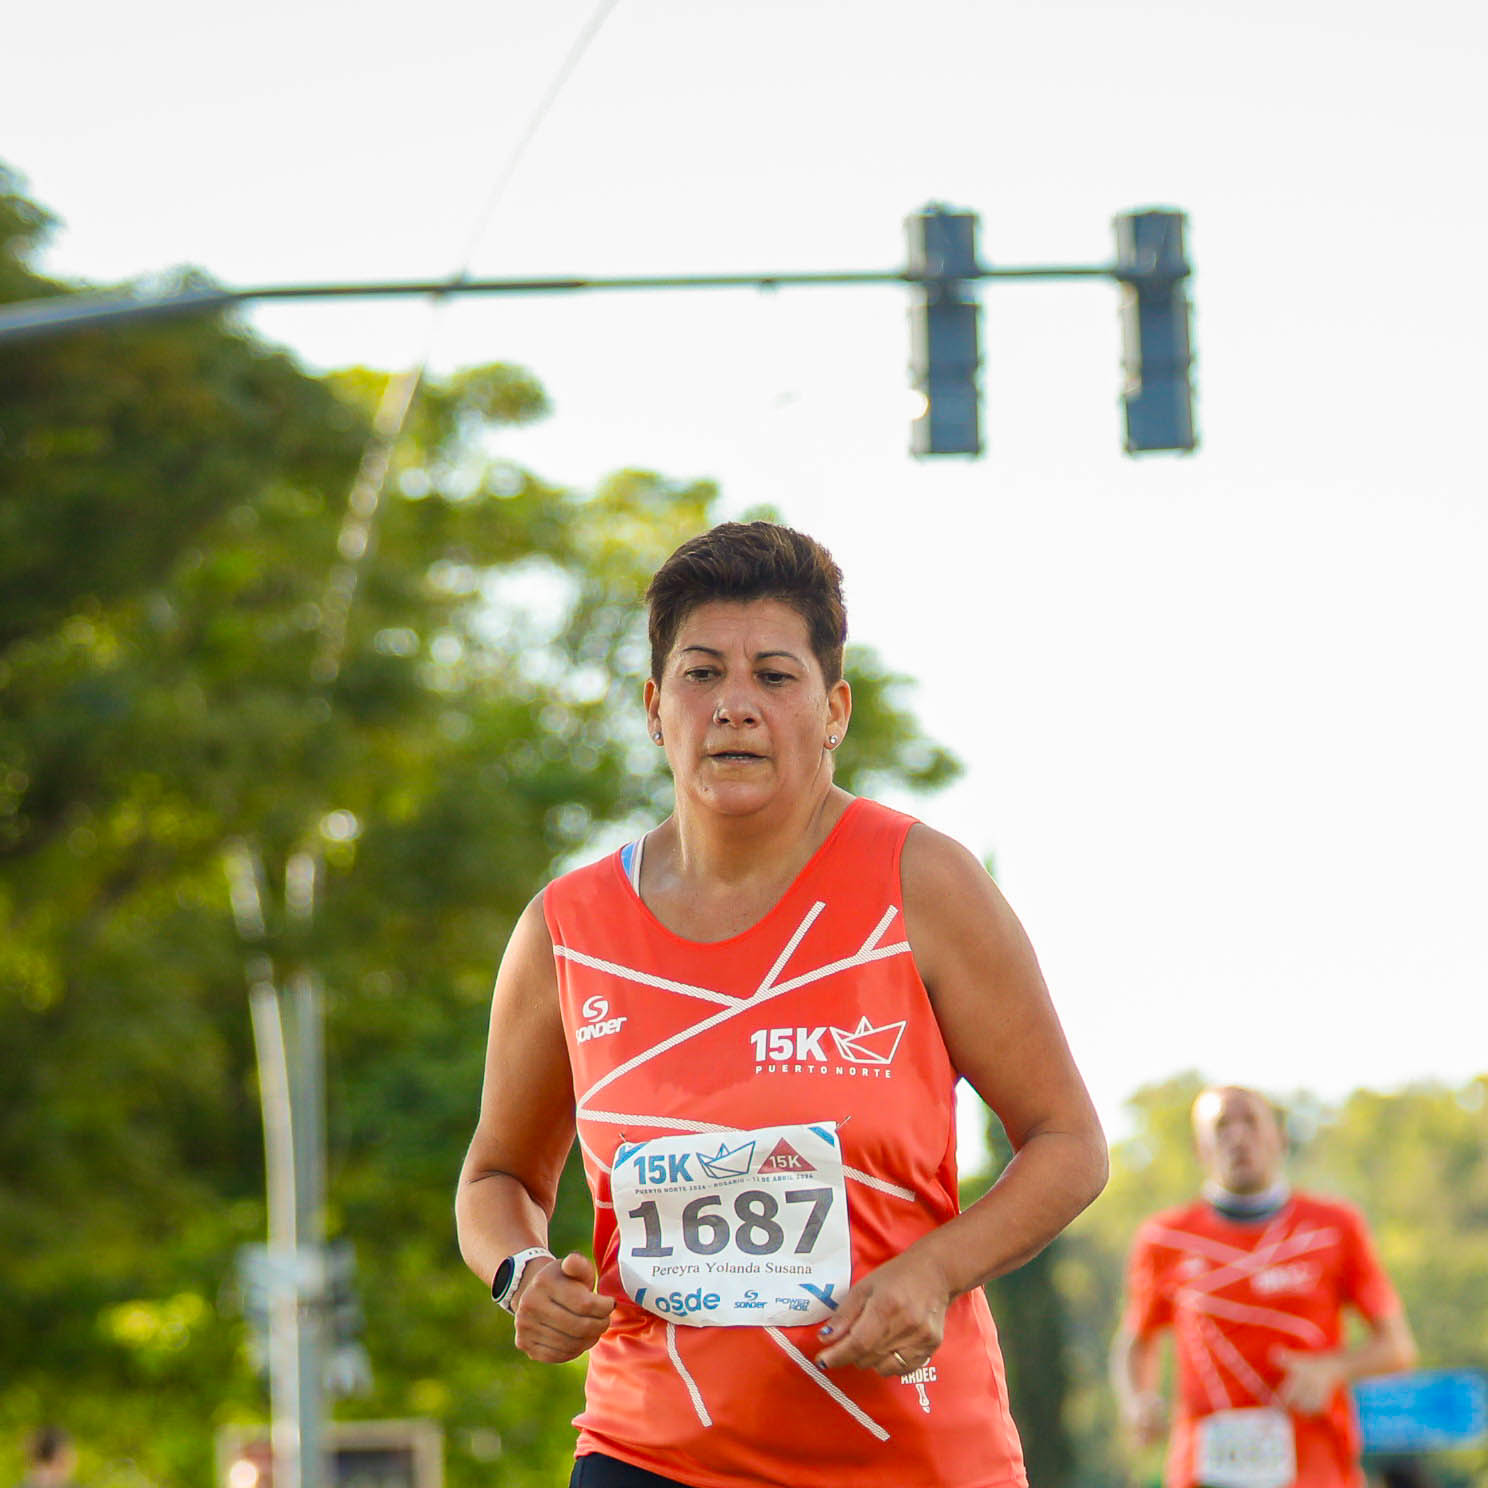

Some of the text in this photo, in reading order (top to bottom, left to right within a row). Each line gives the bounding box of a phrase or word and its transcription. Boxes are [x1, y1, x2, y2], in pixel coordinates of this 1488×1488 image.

[750, 1026, 829, 1062] 15K
[755, 1064, 892, 1079] PUERTO NORTE
[632, 1153, 694, 1186] 15K
[768, 1154, 802, 1169] 15K
[628, 1187, 834, 1258] 1687
[652, 1262, 812, 1277] Pereyra Yolanda Susana
[655, 1287, 721, 1315] osde
